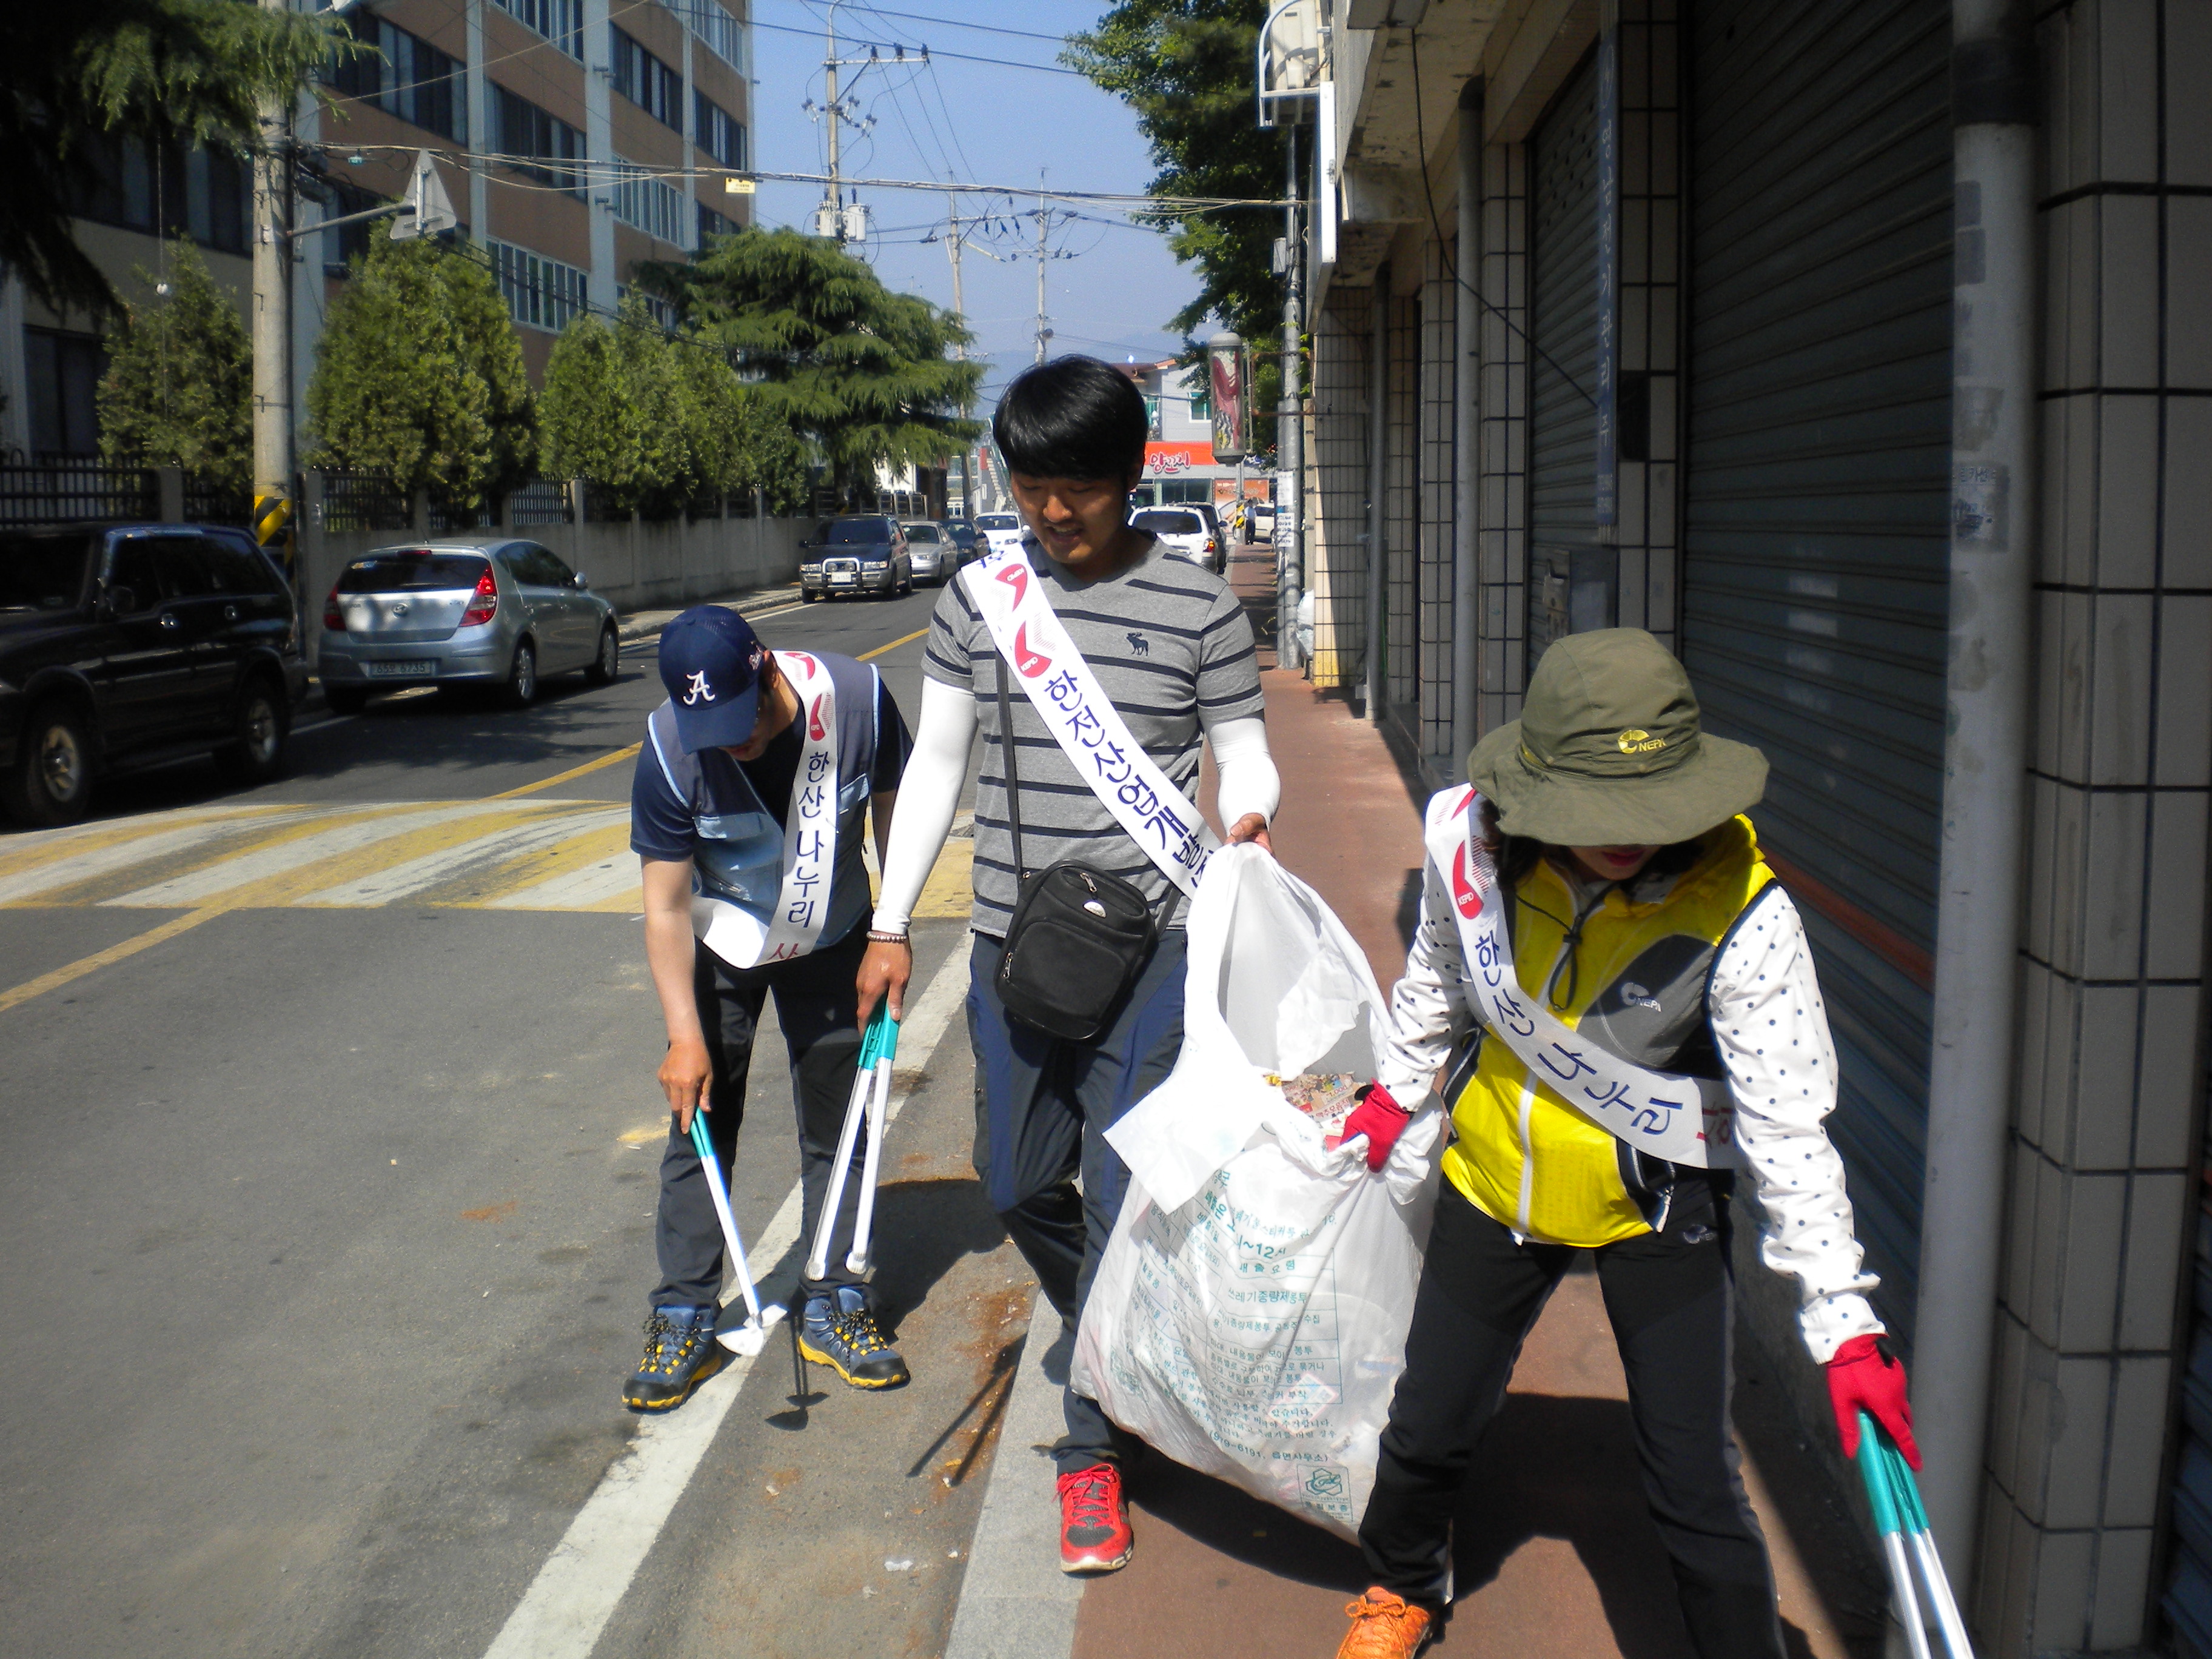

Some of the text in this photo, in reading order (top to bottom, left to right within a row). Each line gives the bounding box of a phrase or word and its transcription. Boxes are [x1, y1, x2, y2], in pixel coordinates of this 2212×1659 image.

[683, 670, 716, 706] A
[1638, 737, 1667, 752] NEPA
[1458, 891, 1475, 907] KEPID
